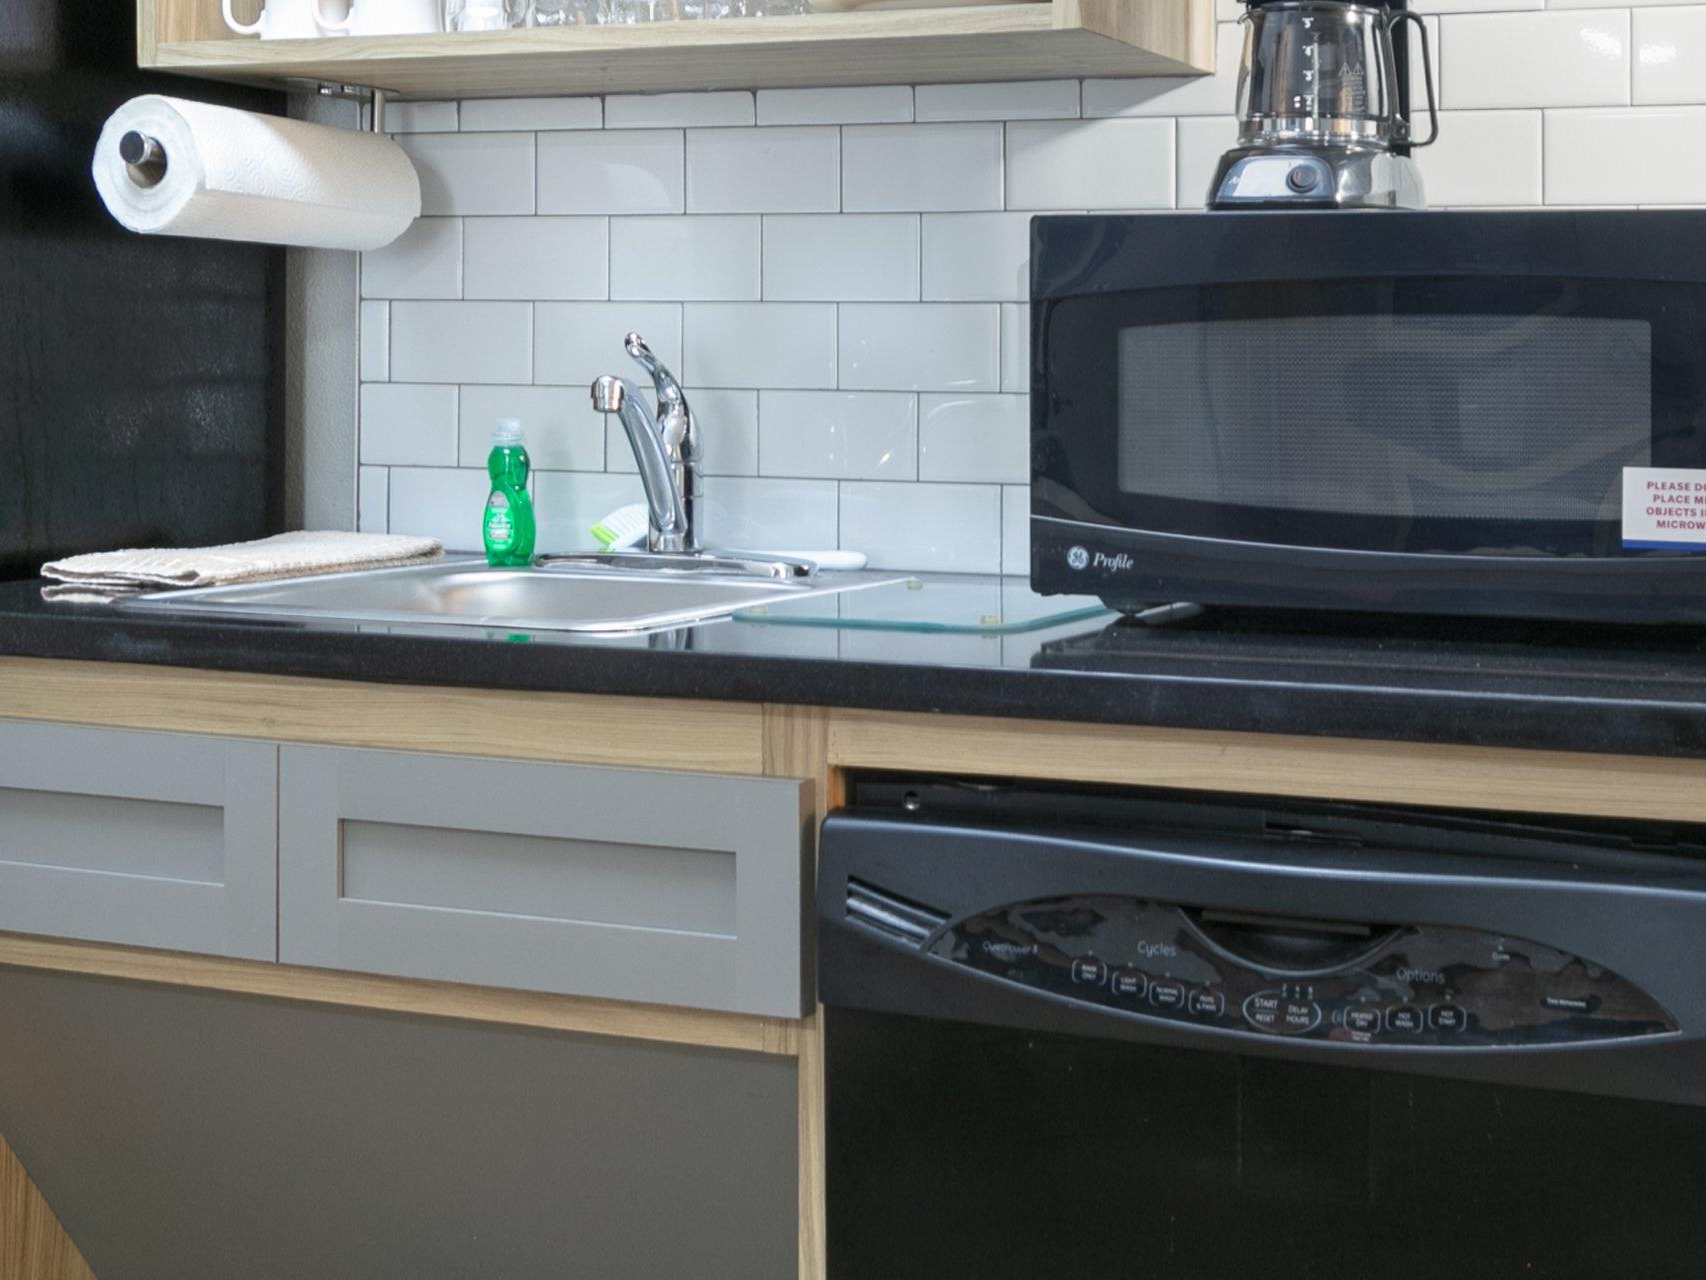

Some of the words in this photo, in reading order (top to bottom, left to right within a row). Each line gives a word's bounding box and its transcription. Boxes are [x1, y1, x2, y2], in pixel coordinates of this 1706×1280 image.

[1646, 481, 1690, 491] PLEASE
[1653, 494, 1690, 504] PLACE
[1646, 506, 1697, 517] OBJECTS
[1093, 552, 1134, 573] Profile
[1137, 940, 1176, 957] Cycles
[1397, 967, 1446, 984] Options
[1254, 997, 1278, 1008] START
[1288, 1004, 1309, 1015] DELAY
[1255, 1013, 1275, 1023] RESET
